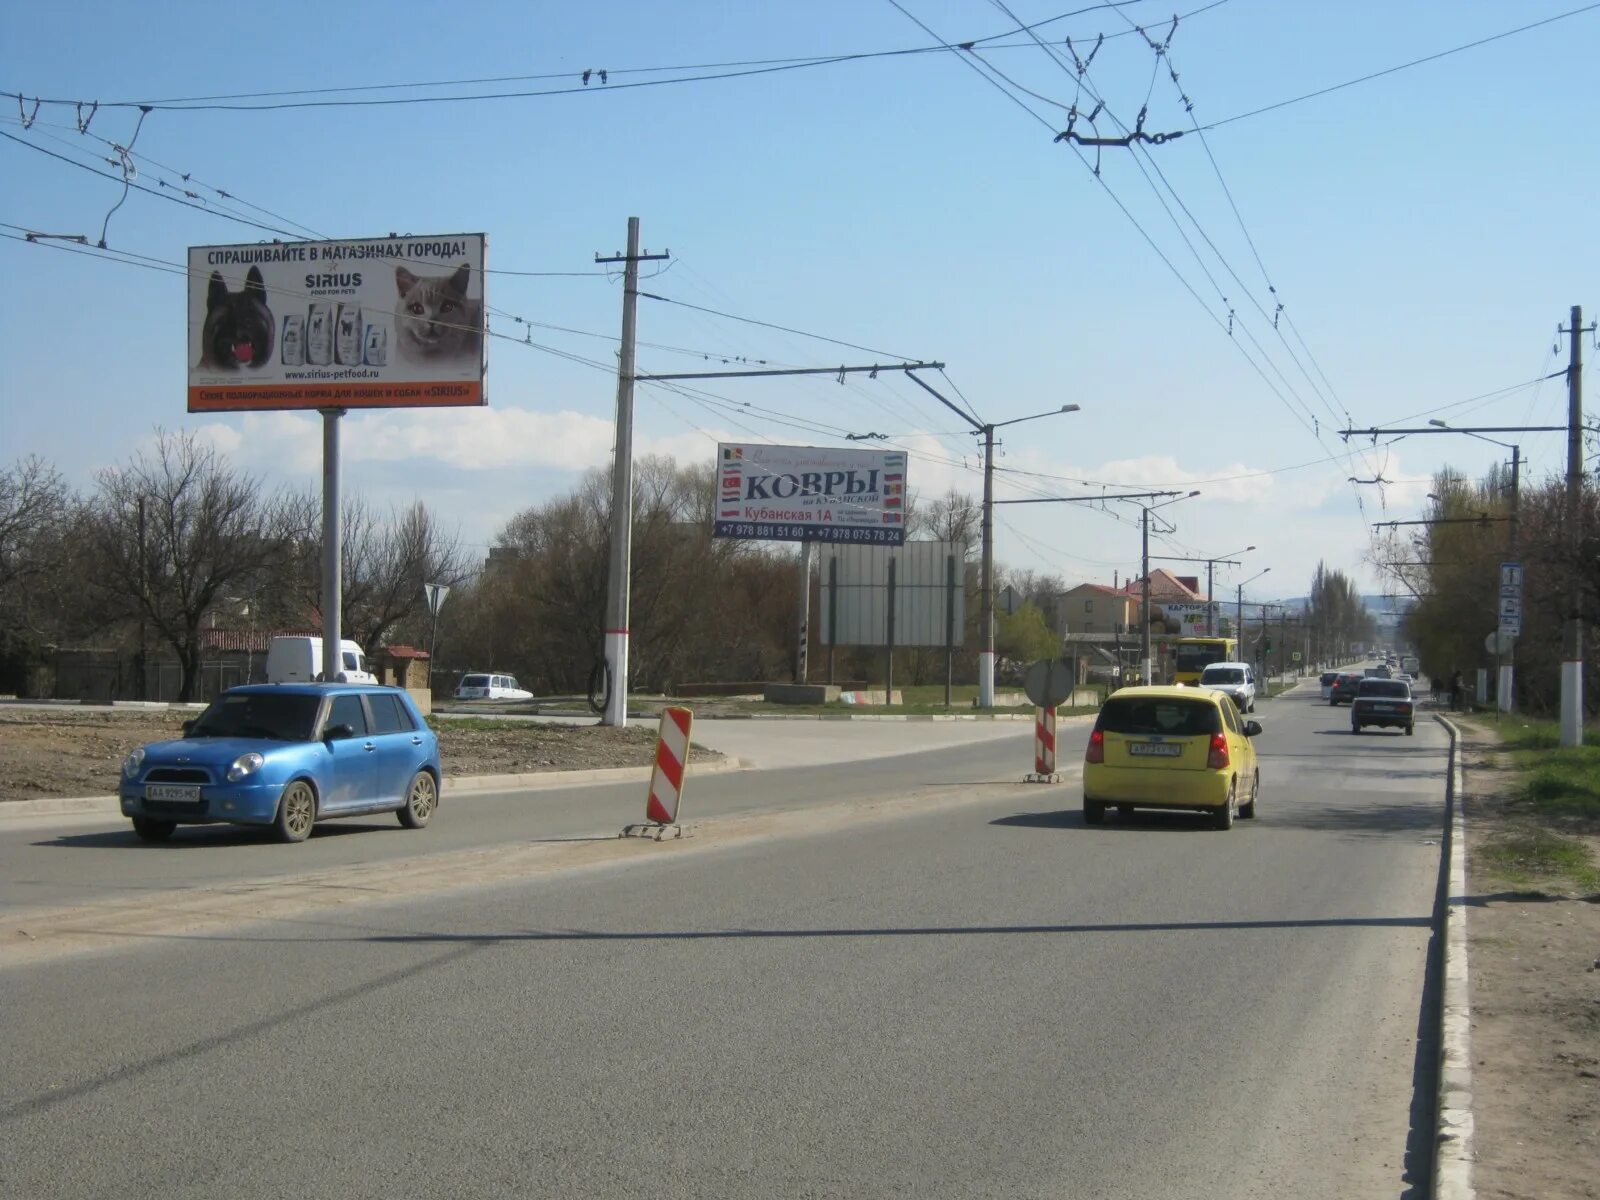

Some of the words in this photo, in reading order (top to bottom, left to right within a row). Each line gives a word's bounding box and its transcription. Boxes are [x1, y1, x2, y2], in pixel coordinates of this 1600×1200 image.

[208, 244, 305, 265] СПРАШИВАЙТЕ
[309, 247, 318, 260] В
[322, 244, 402, 260] МАГАЗИНАХ
[407, 241, 466, 257] ГОРОДА!
[305, 272, 362, 288] SIRIUS
[285, 368, 379, 380] www.sirius-petfood.ru
[745, 469, 880, 500] КОВРЫ
[745, 507, 812, 522] Кубанская
[816, 510, 833, 522] 1А
[721, 526, 733, 535] +7
[737, 526, 754, 536] 978
[757, 526, 774, 536] 881
[776, 526, 789, 537] 51
[817, 530, 830, 539] +7
[833, 530, 851, 540] 978
[853, 530, 870, 540] 075
[872, 531, 885, 541] 78
[887, 532, 900, 541] 24
